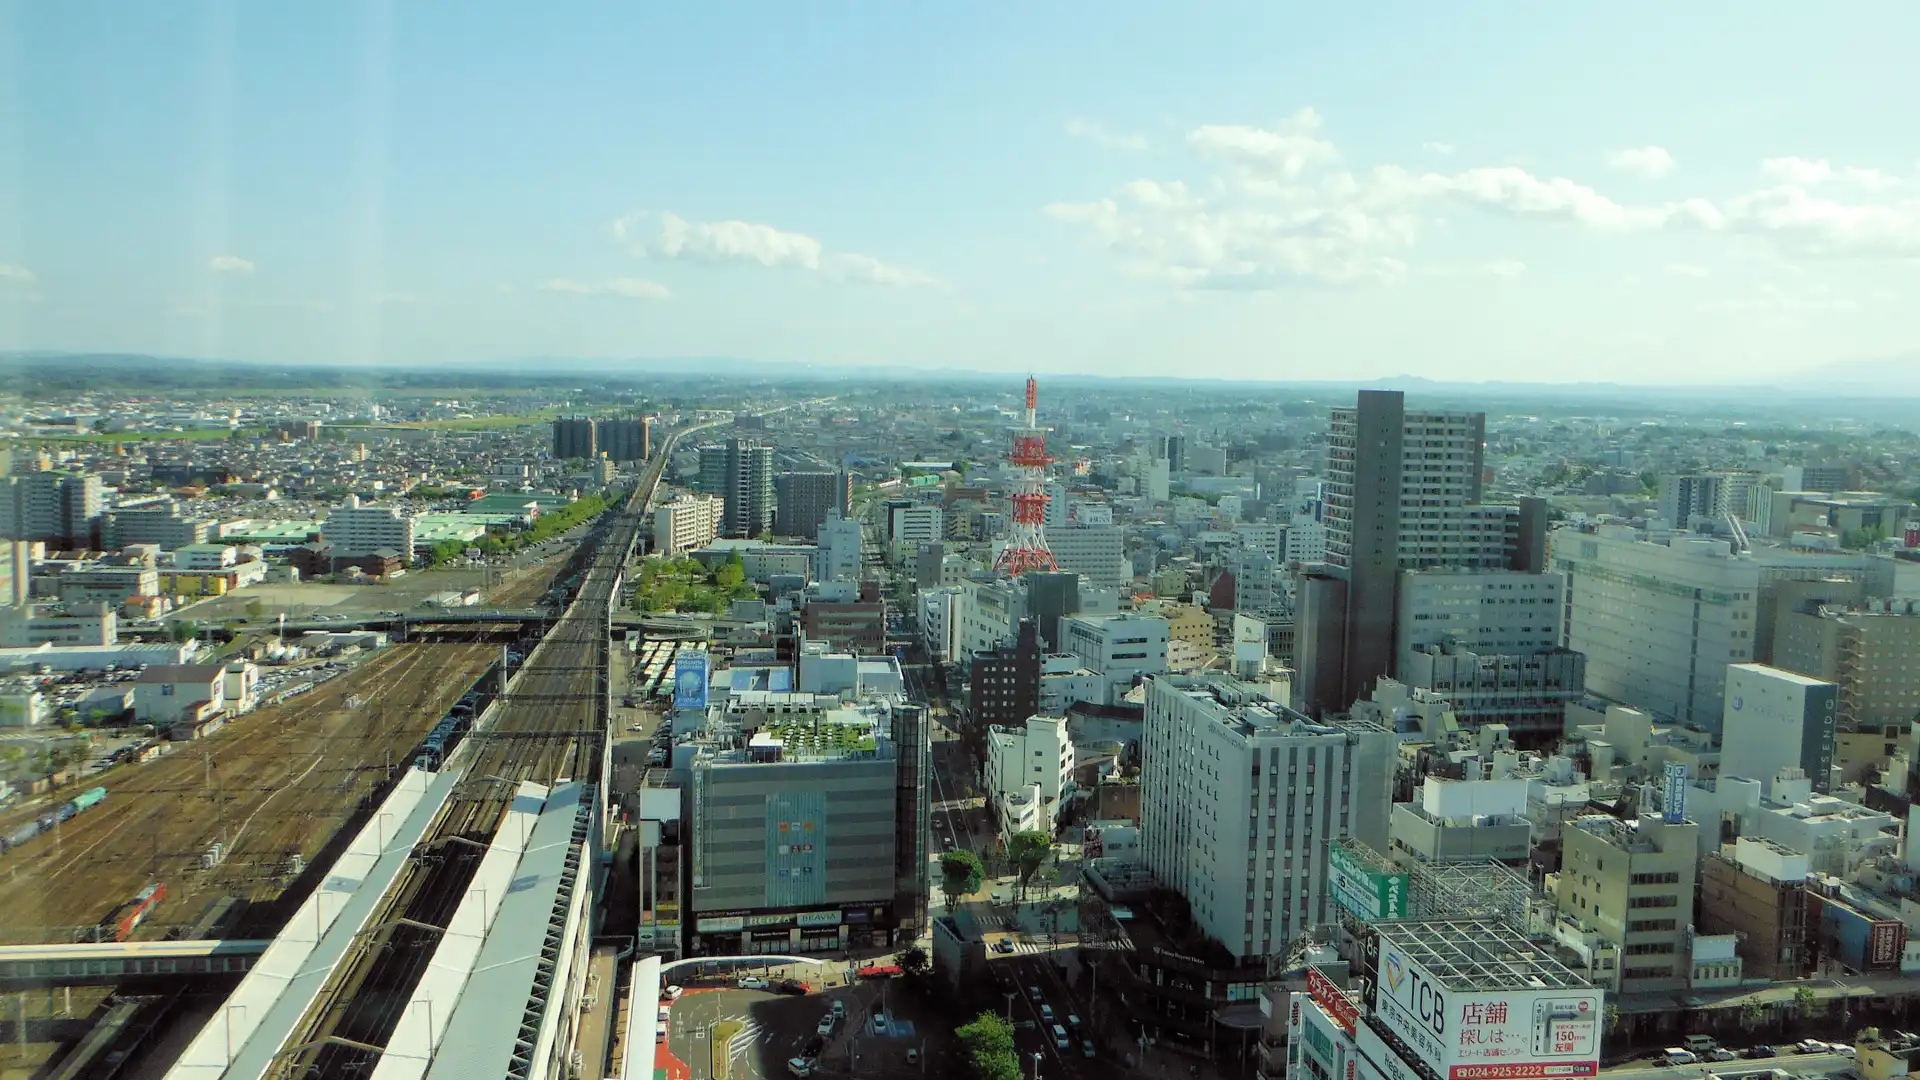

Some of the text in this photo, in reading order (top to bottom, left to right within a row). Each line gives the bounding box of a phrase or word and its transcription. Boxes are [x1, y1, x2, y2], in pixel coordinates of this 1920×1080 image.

[803, 912, 836, 922] BRAVIA
[1366, 936, 1378, 957] 8F
[1364, 975, 1376, 999] 7F
[1408, 967, 1445, 1034] TCB
[1461, 1002, 1508, 1025] 店舗
[1468, 1066, 1541, 1077] 024-925-2222
